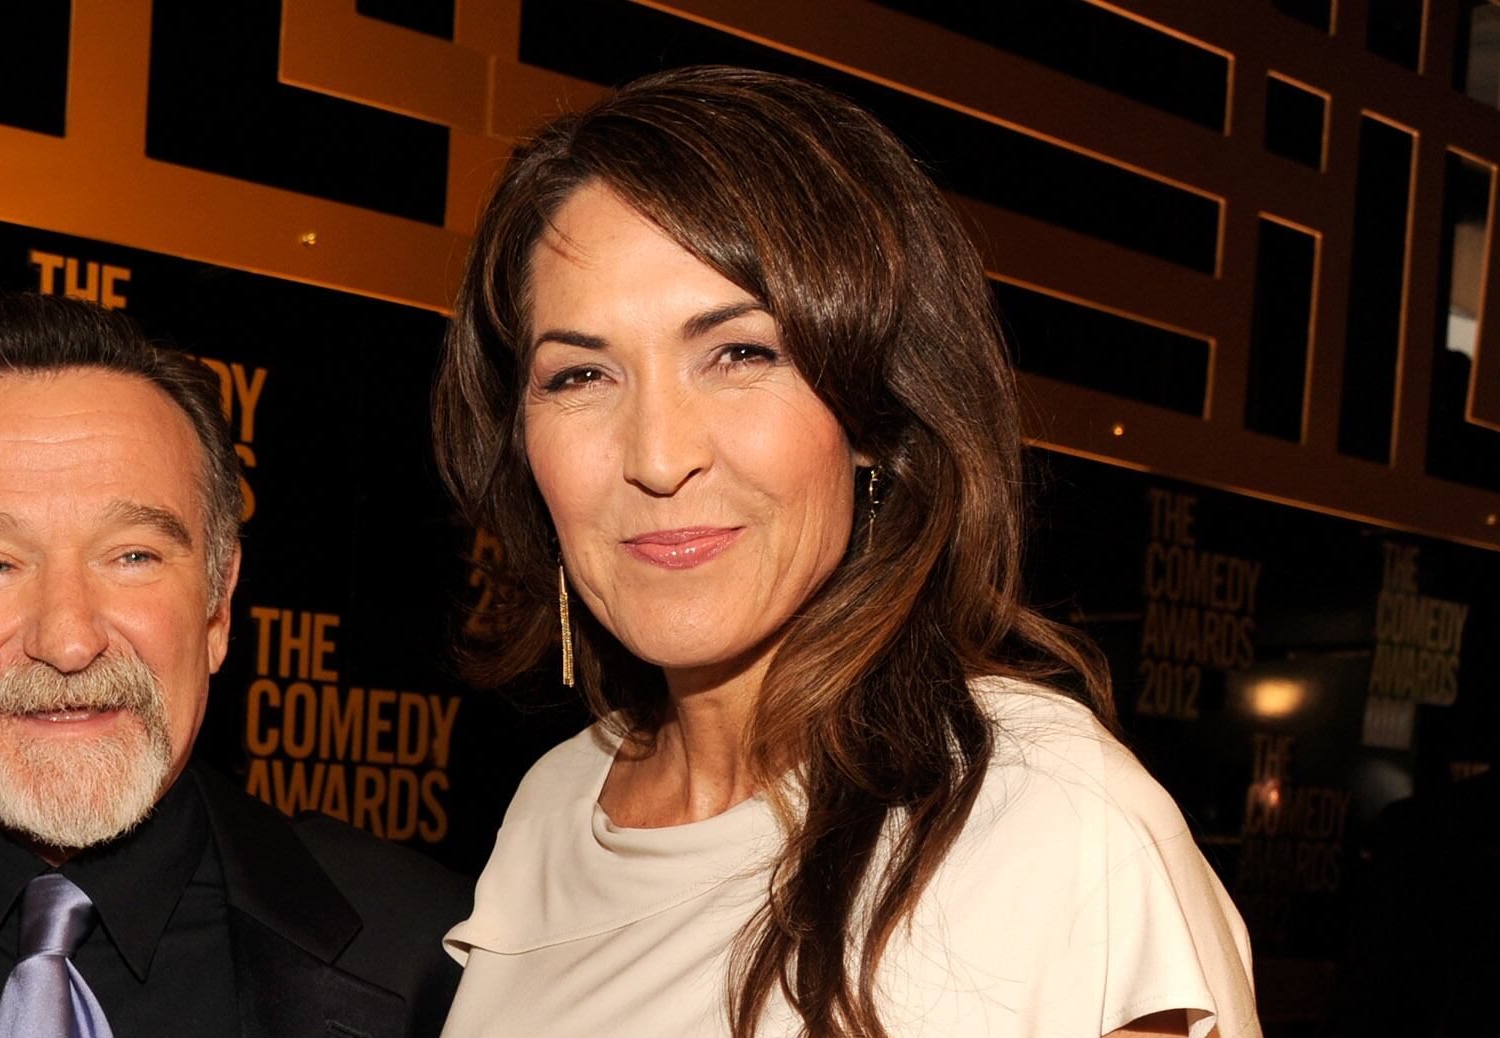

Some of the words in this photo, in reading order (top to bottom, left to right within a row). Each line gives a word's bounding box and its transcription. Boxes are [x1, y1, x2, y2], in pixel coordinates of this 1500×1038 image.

[1147, 487, 1197, 545] THE
[1145, 542, 1263, 614] COMEDY
[250, 605, 341, 683] THE
[1140, 600, 1256, 670] AWARDS
[245, 678, 463, 769] COMEDY
[246, 758, 451, 845] AWARDS
